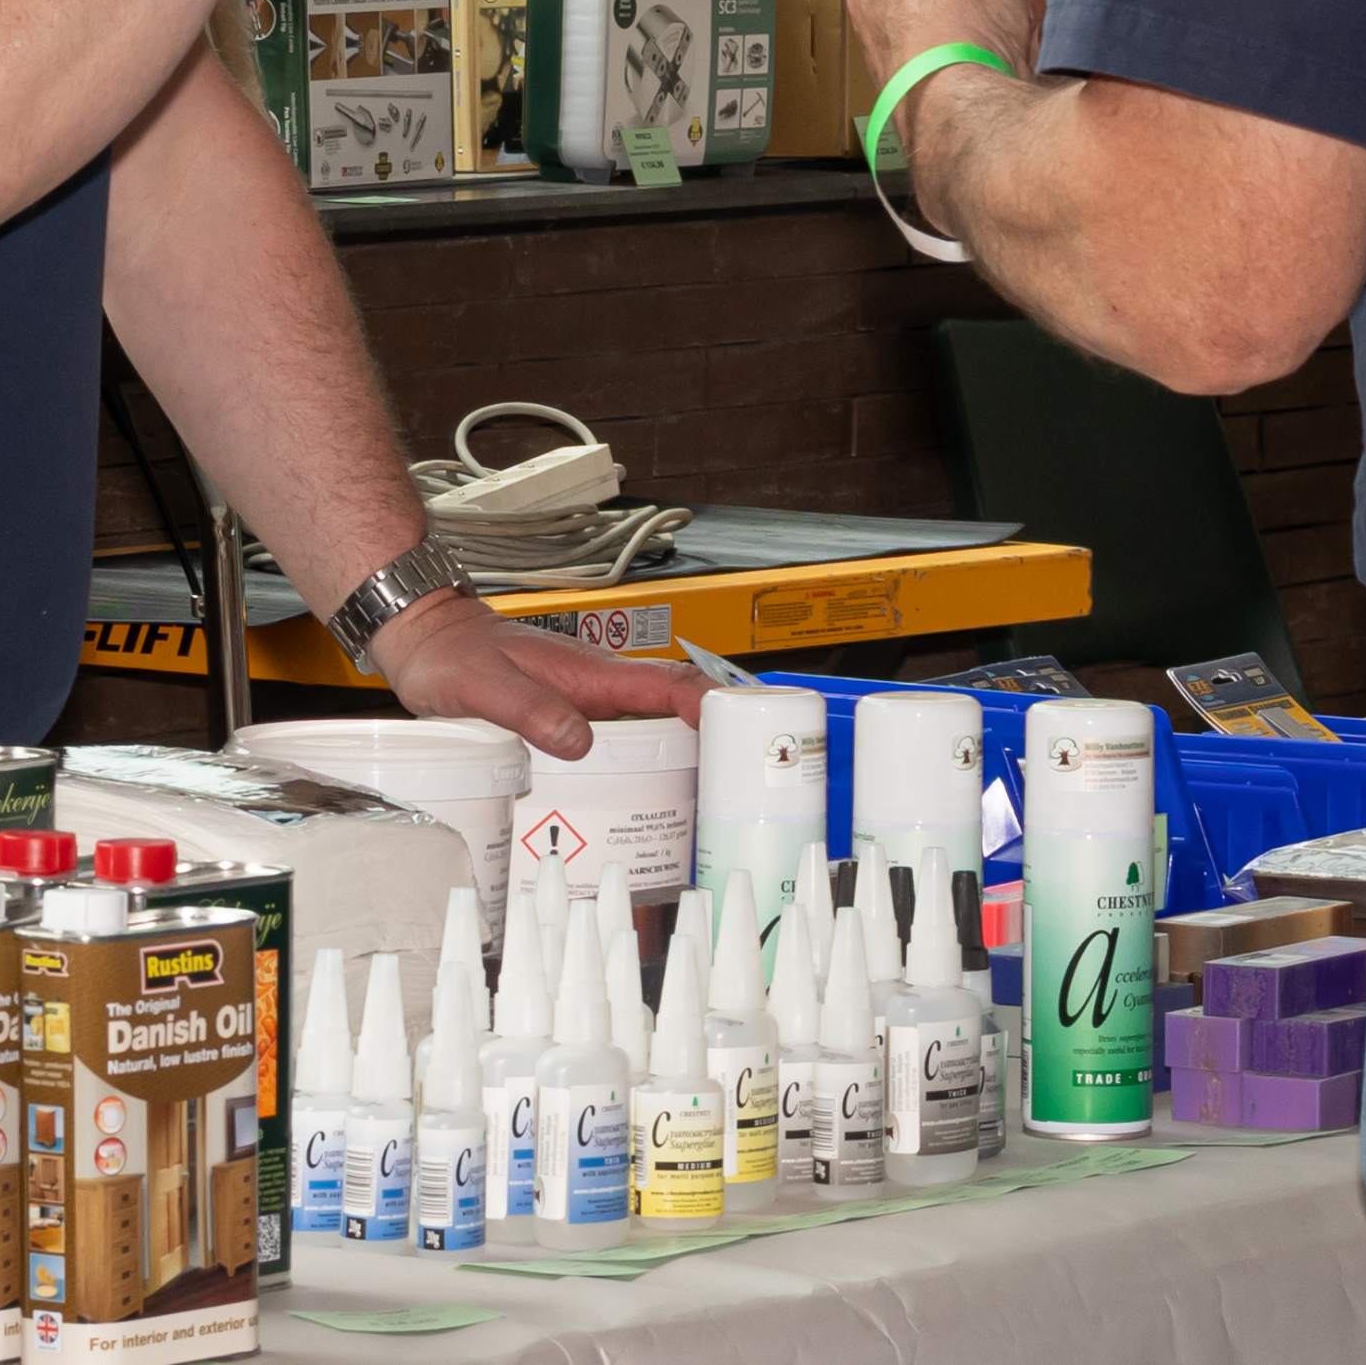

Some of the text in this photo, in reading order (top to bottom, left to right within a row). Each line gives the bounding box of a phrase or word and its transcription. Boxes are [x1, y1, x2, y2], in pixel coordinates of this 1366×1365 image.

[718, 0, 736, 15] SC3
[25, 954, 61, 969] Rustins
[147, 950, 214, 978] Rustins
[106, 996, 180, 1017] The Original
[107, 1002, 253, 1054] Danish Oil
[107, 1041, 253, 1075] Natural, low lustre finish
[1076, 1073, 1122, 1085] TRADE
[677, 1162, 711, 1170] MEDIUM
[89, 1318, 244, 1352] For interior and exterior
